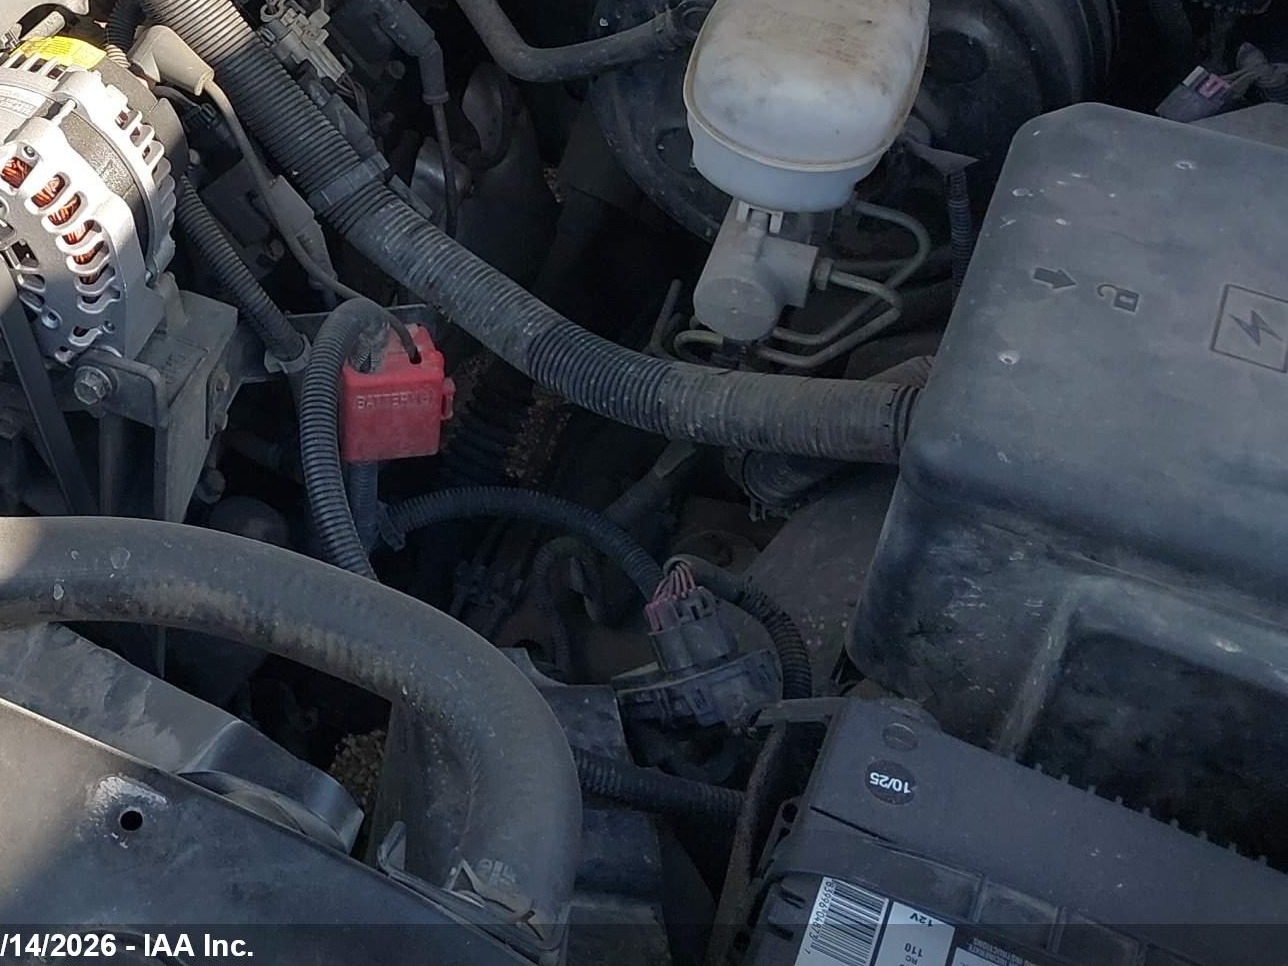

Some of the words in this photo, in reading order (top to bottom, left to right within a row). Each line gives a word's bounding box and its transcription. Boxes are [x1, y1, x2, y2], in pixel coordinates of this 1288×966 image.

[355, 389, 416, 410] BATTERY
[869, 771, 912, 794] 10/25
[909, 912, 934, 927] 12V
[904, 942, 924, 958] 110
[905, 955, 919, 965] RC
